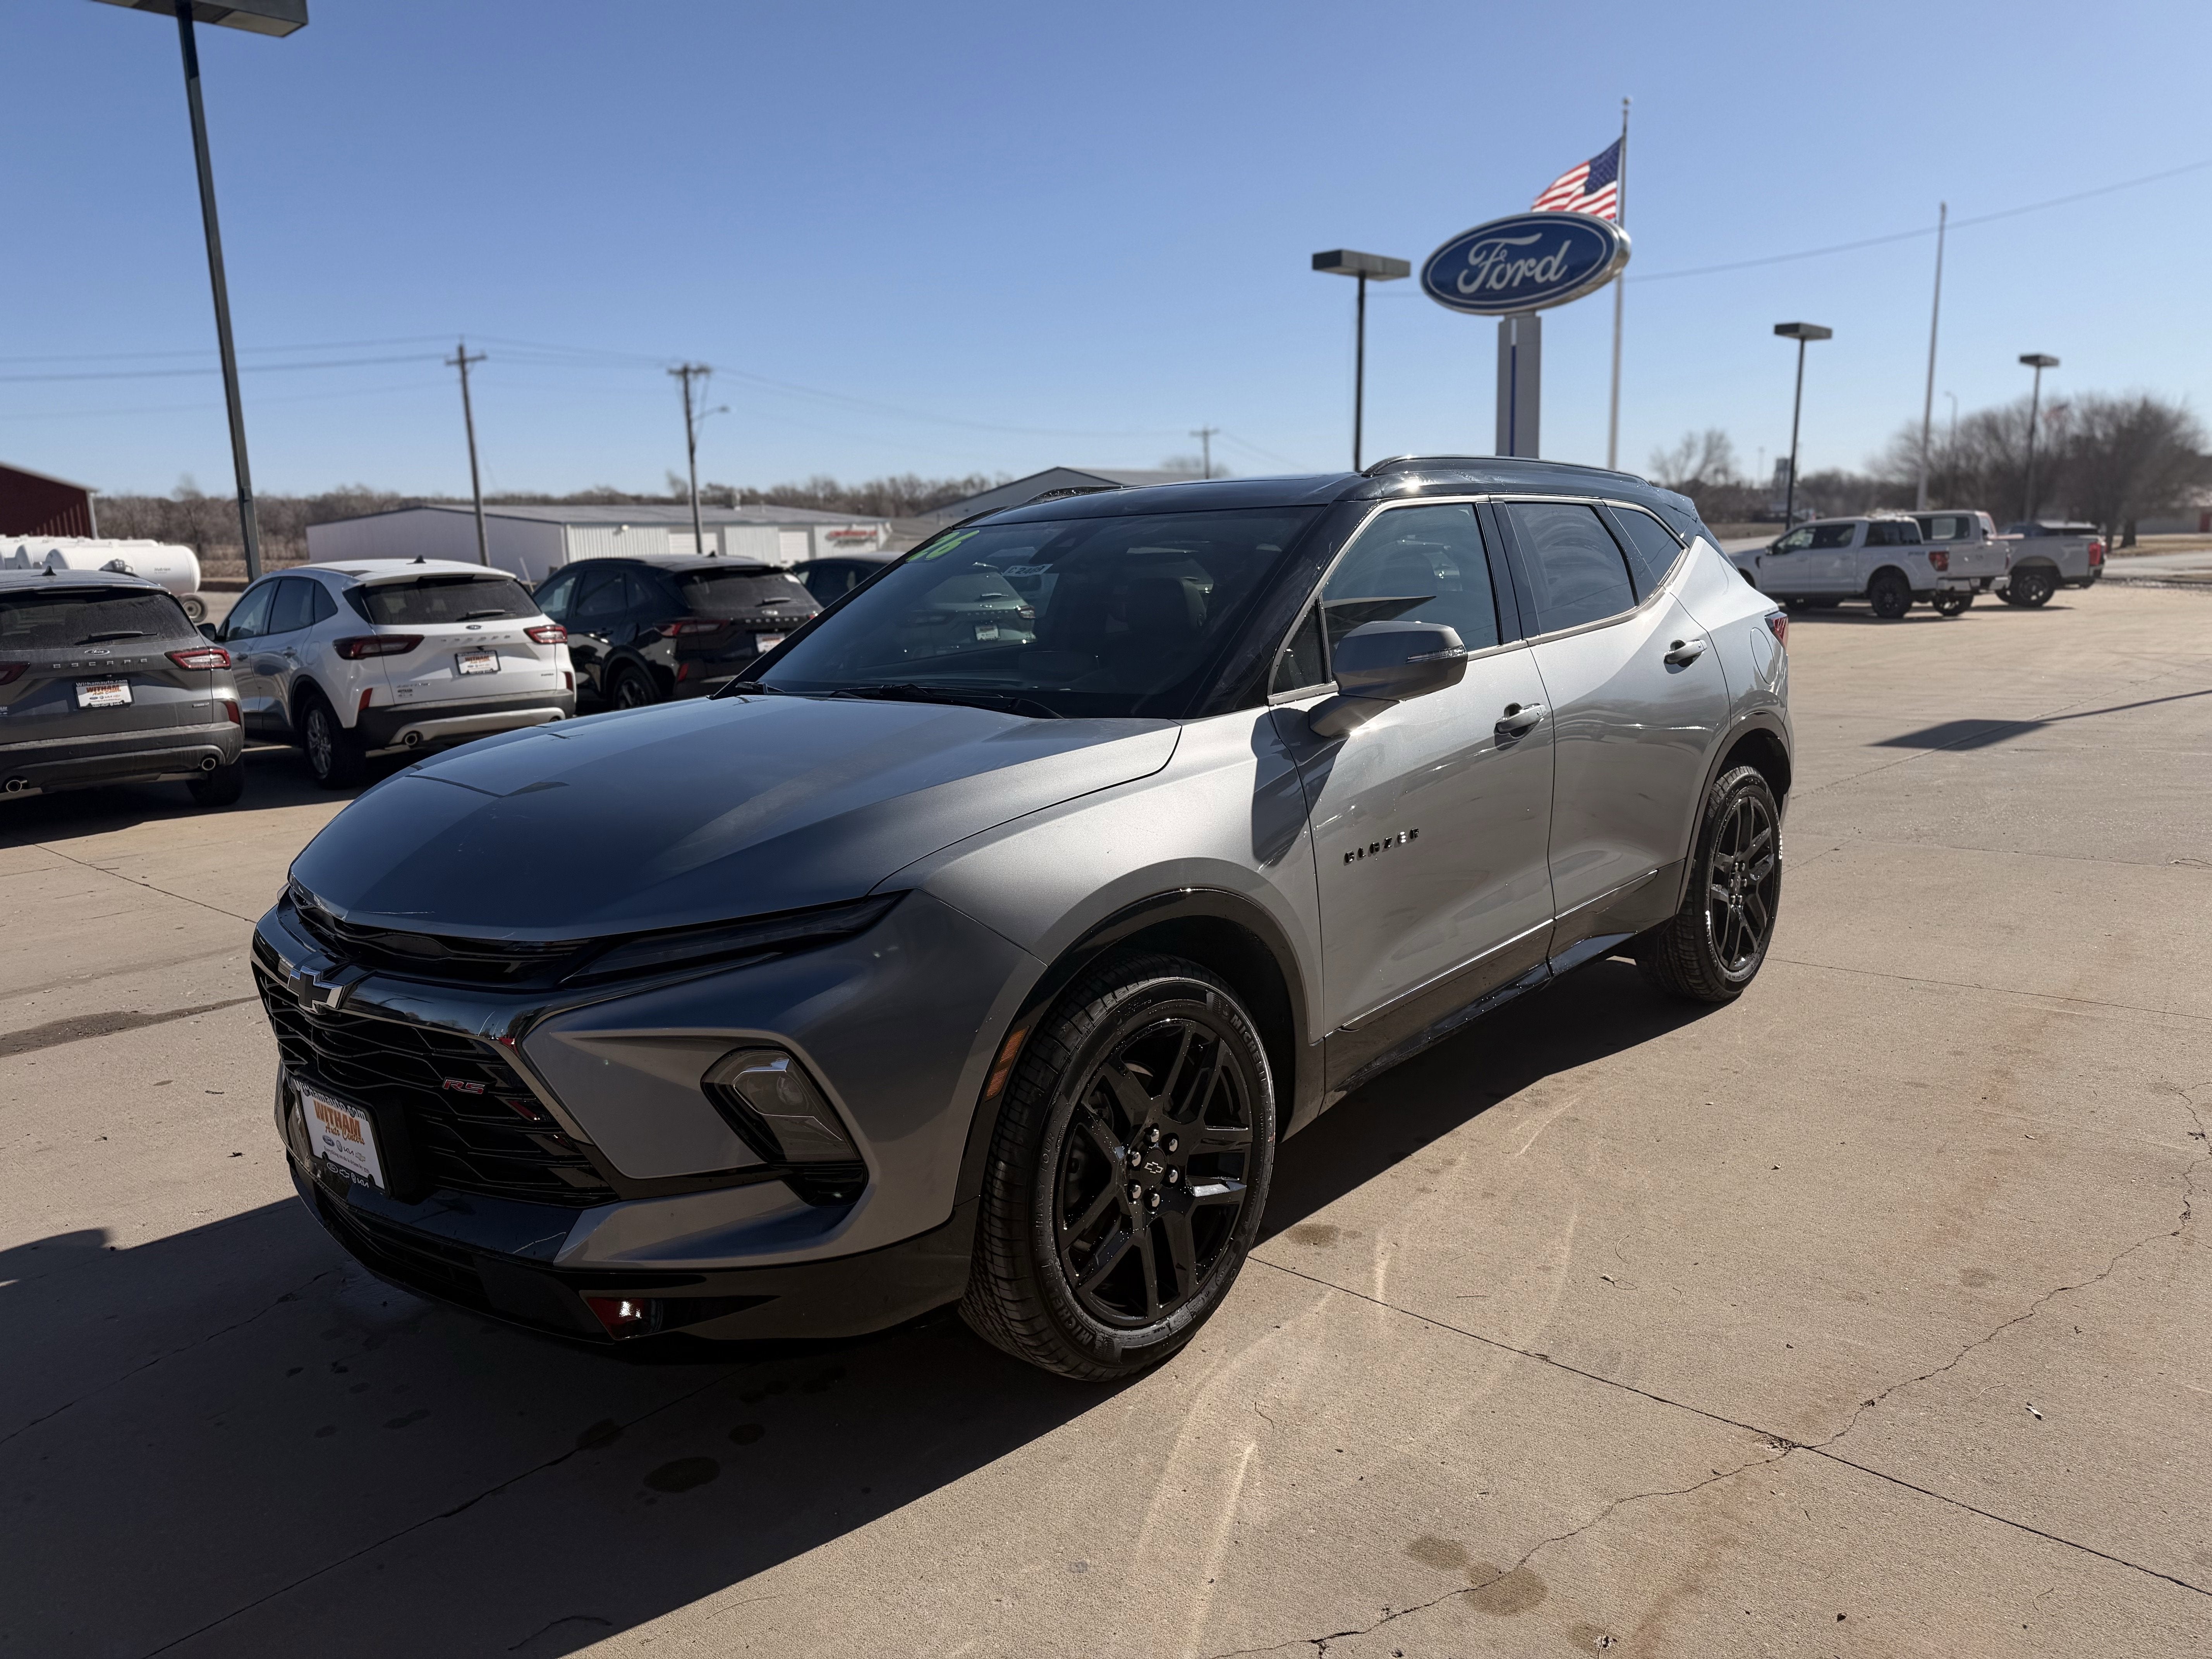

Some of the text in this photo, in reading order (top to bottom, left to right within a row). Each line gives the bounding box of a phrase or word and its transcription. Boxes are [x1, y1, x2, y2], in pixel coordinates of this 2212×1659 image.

[1457, 232, 1571, 294] Ford
[1344, 828, 1419, 863] BLAZER
[293, 1079, 367, 1120] Withamauto.com
[443, 1079, 486, 1094] RS
[313, 1099, 361, 1139] WITHAM
[325, 1122, 365, 1145] Auto Centers
[1035, 1181, 1046, 1247] PRIMACY
